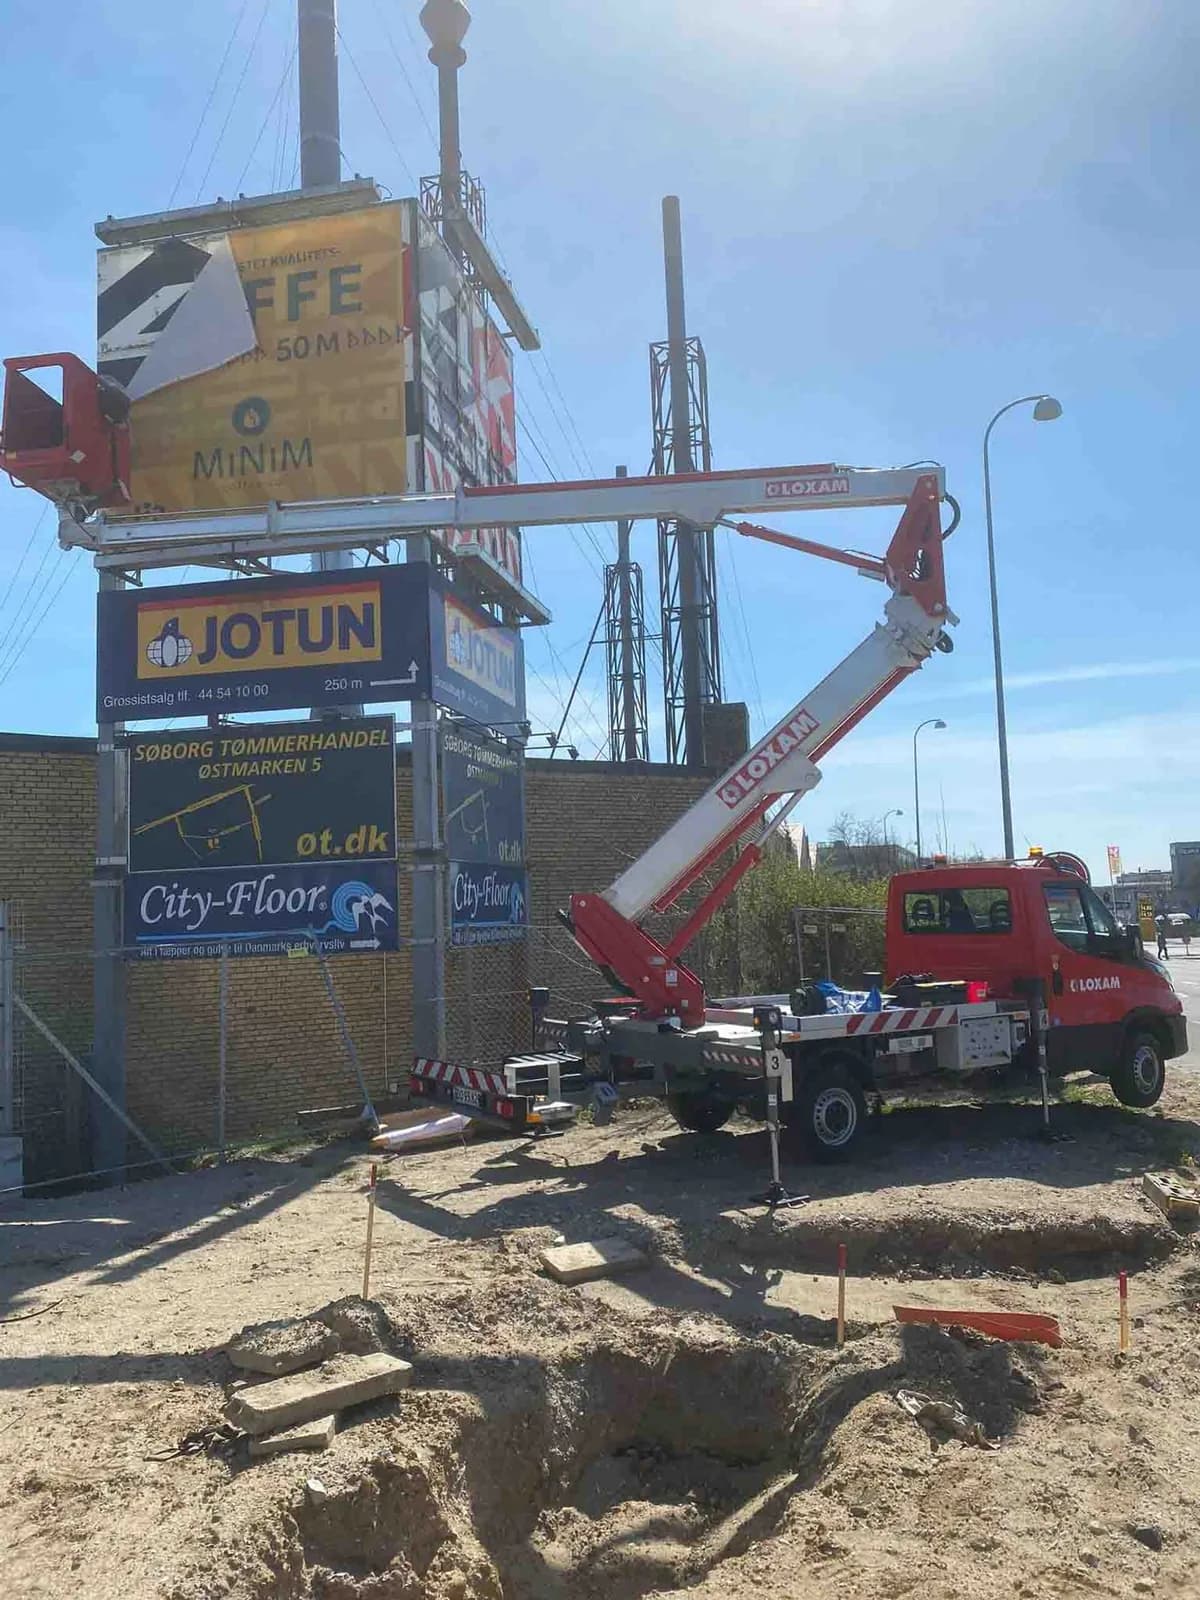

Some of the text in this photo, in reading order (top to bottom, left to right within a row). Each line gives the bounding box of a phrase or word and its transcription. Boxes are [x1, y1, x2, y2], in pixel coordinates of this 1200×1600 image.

[242, 263, 363, 327] FFE
[276, 335, 311, 363] 50
[782, 480, 848, 496] LOXAM
[198, 602, 376, 666] JOTUN
[103, 691, 175, 708] Grossistsalg
[198, 688, 213, 701] 44
[216, 687, 231, 699] 54
[236, 686, 250, 698] 10
[254, 684, 269, 697] 00
[325, 678, 363, 691] 250 m
[134, 729, 390, 762] SØBORG TØMMERHANDEL
[735, 711, 816, 792] LOXAM
[199, 757, 322, 779] ØSTMARKEN 5
[296, 824, 390, 856] øt.dk
[1080, 975, 1120, 992] LOXAM
[771, 1056, 779, 1070] 3
